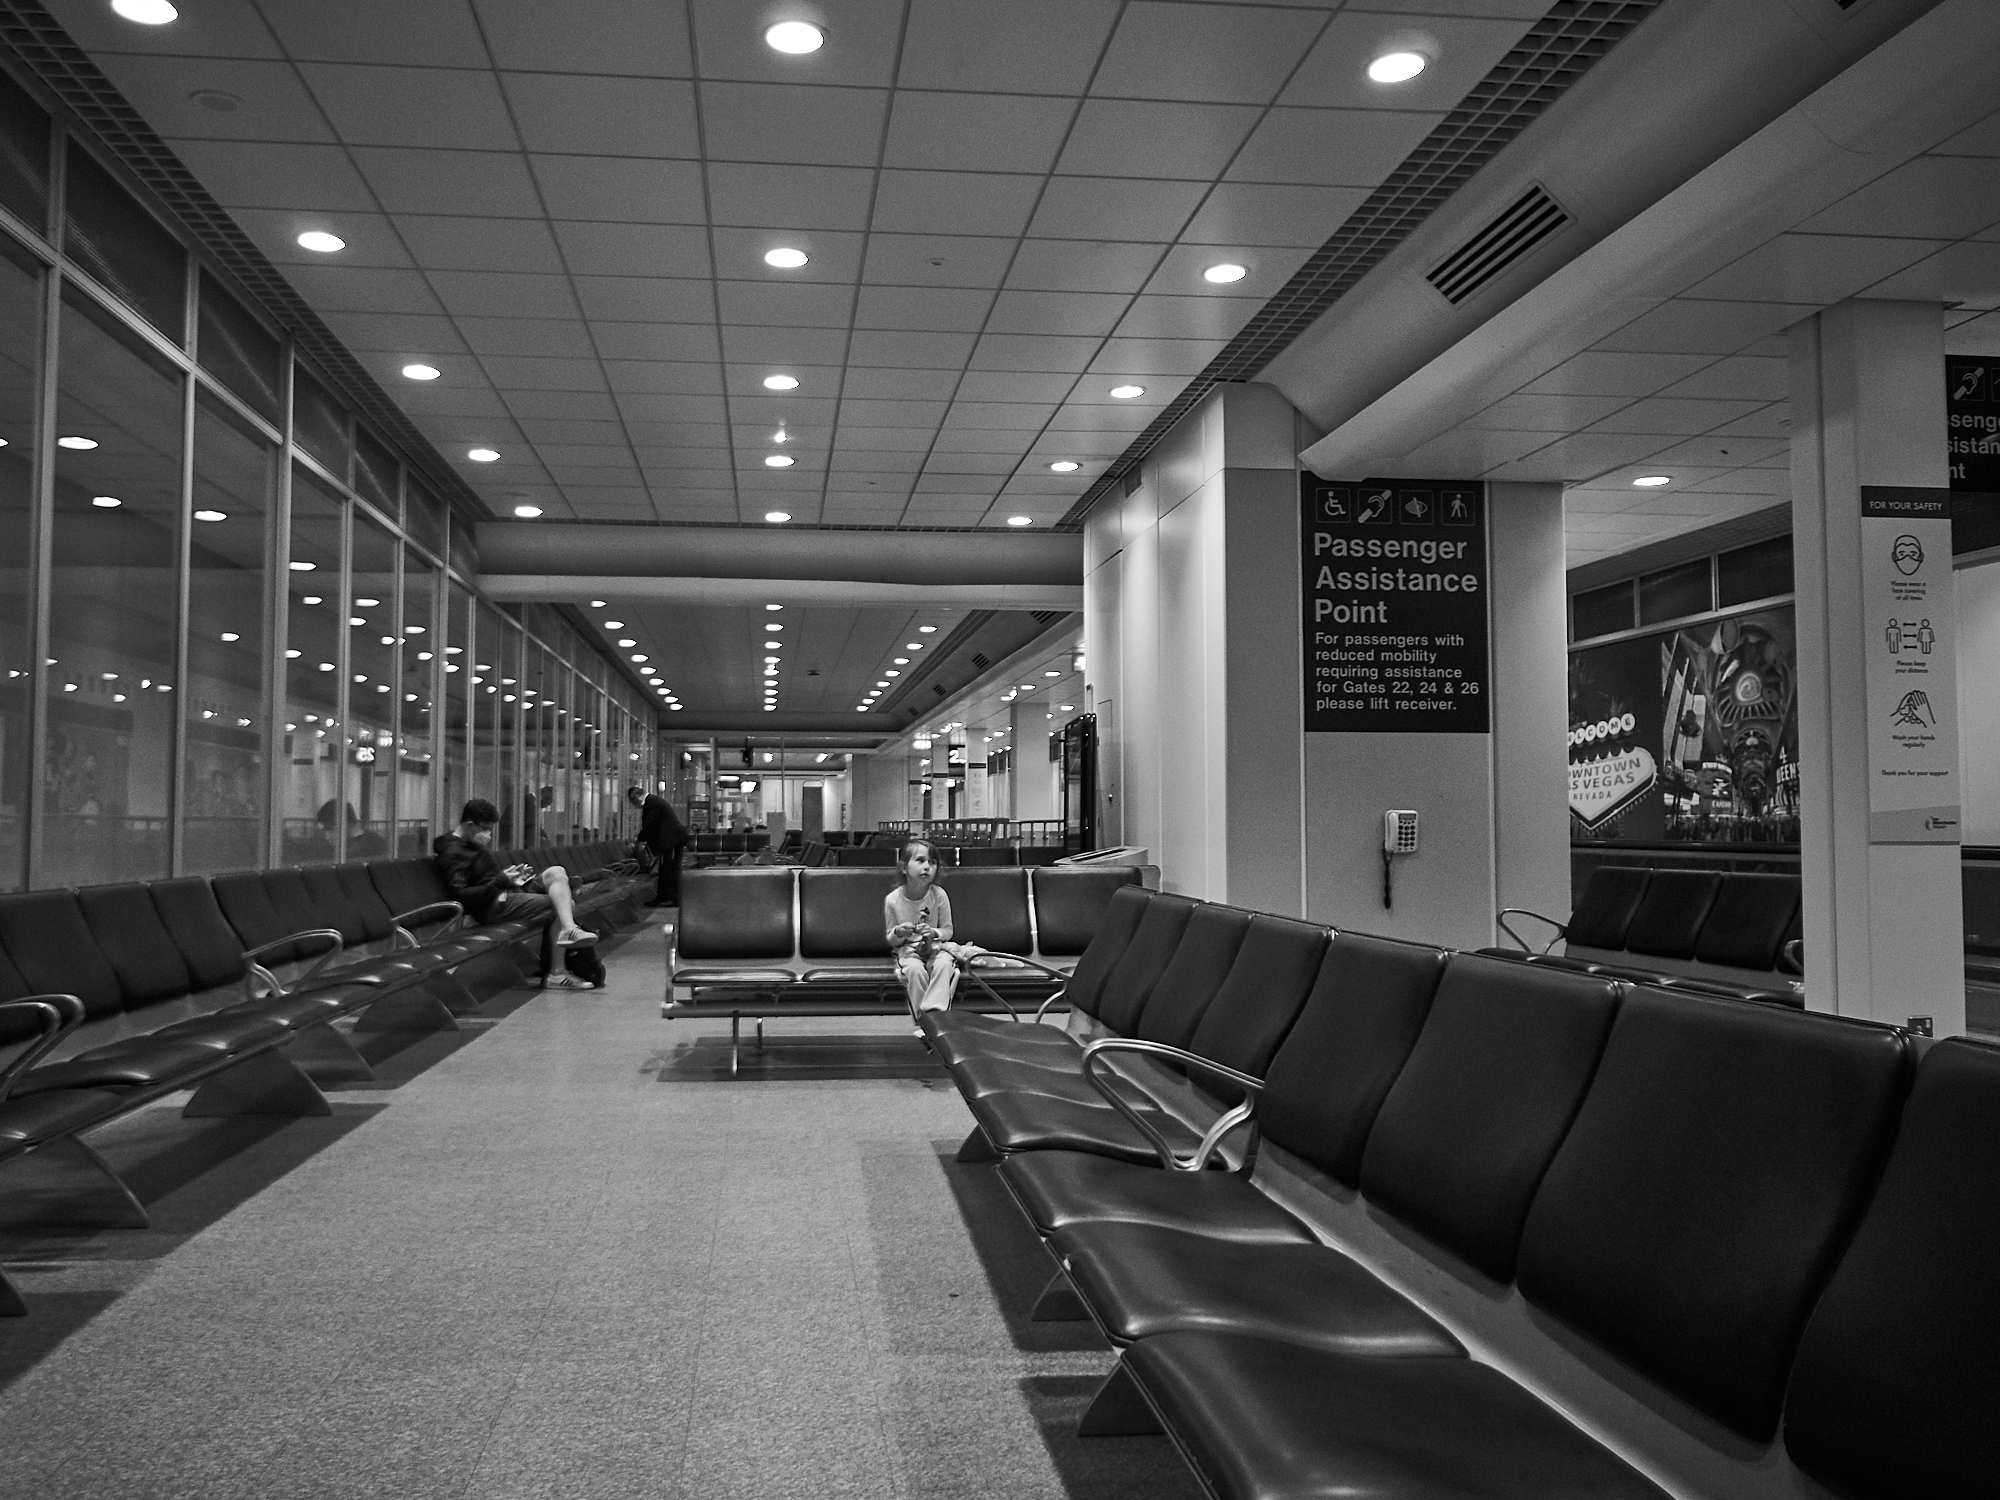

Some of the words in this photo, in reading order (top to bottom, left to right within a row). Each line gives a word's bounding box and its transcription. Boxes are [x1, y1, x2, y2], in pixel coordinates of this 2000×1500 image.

[1948, 414, 2000, 432] seng
[1870, 501, 1887, 509] FOR
[1889, 502, 1912, 510] YOUR
[1914, 502, 1943, 511] SAFETY
[1314, 532, 1468, 564] Passenger
[1315, 565, 1479, 593] Assistance
[1315, 598, 1388, 624] Point
[1315, 632, 1339, 645] For
[1345, 634, 1429, 648] passengers
[1435, 634, 1464, 646] with
[1316, 648, 1375, 661] reduced
[1381, 650, 1437, 664] mobility
[1316, 665, 1379, 680] requiring
[1385, 666, 1463, 678] assistance
[1316, 681, 1337, 693] for
[1343, 681, 1386, 694] Gates
[1392, 681, 1414, 696] 22,
[1420, 682, 1437, 694] 24
[1444, 682, 1454, 694] &
[1461, 682, 1479, 695] 26
[1316, 697, 1364, 712] please
[1370, 697, 1389, 710] lift
[1396, 698, 1457, 710] receiver.
[1569, 757, 1641, 779] WNTOWN
[1569, 780, 1579, 790] S
[1583, 772, 1636, 789] VEGAS
[1573, 791, 1612, 800] NEVADA
